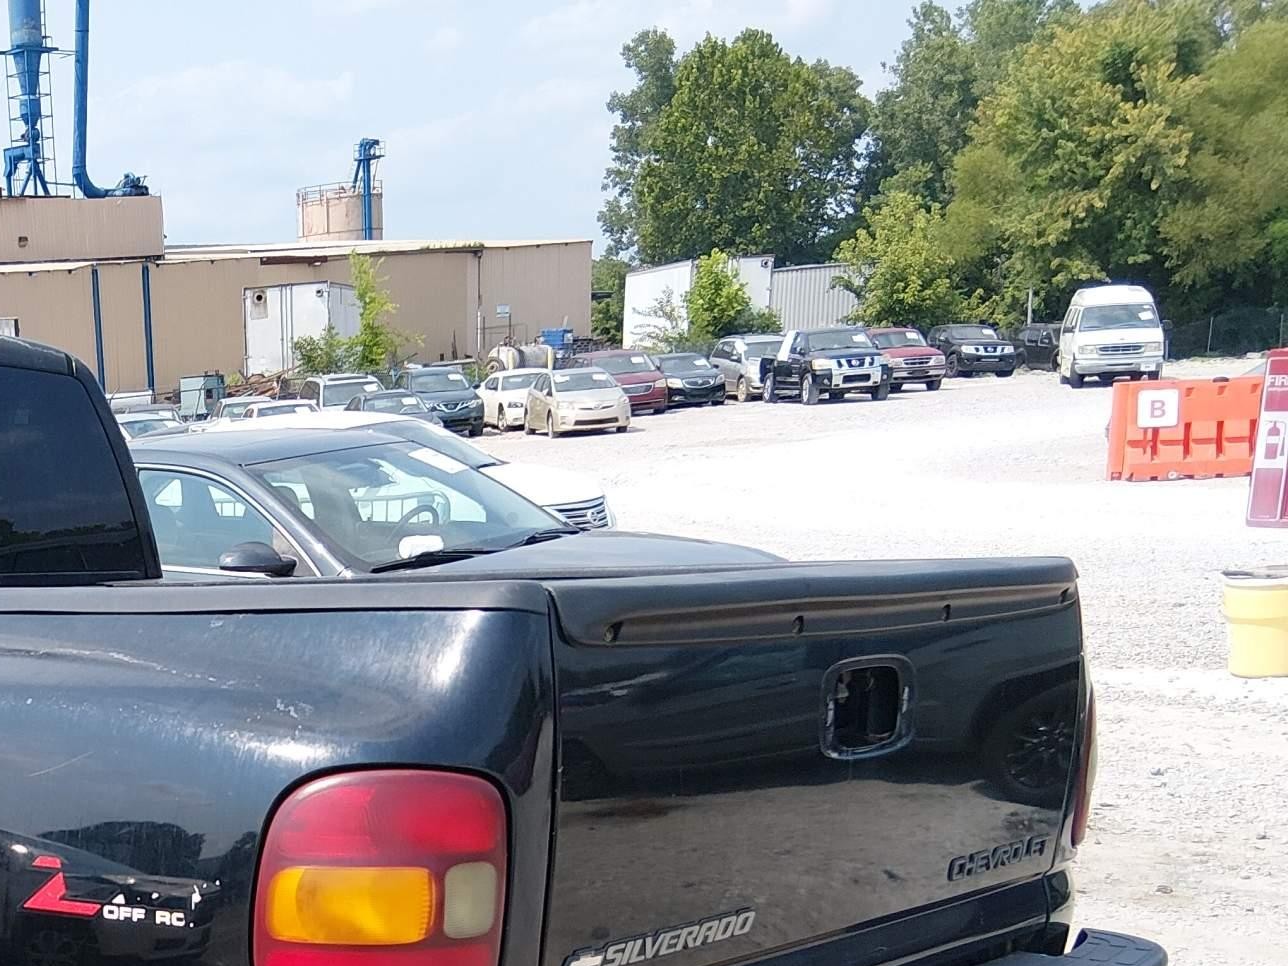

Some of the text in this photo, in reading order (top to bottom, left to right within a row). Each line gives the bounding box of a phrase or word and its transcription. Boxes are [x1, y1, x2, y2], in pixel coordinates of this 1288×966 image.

[1268, 374, 1288, 386] FIR
[1150, 399, 1166, 419] B
[947, 834, 1049, 881] CHEVROLET
[103, 905, 146, 922] OFF
